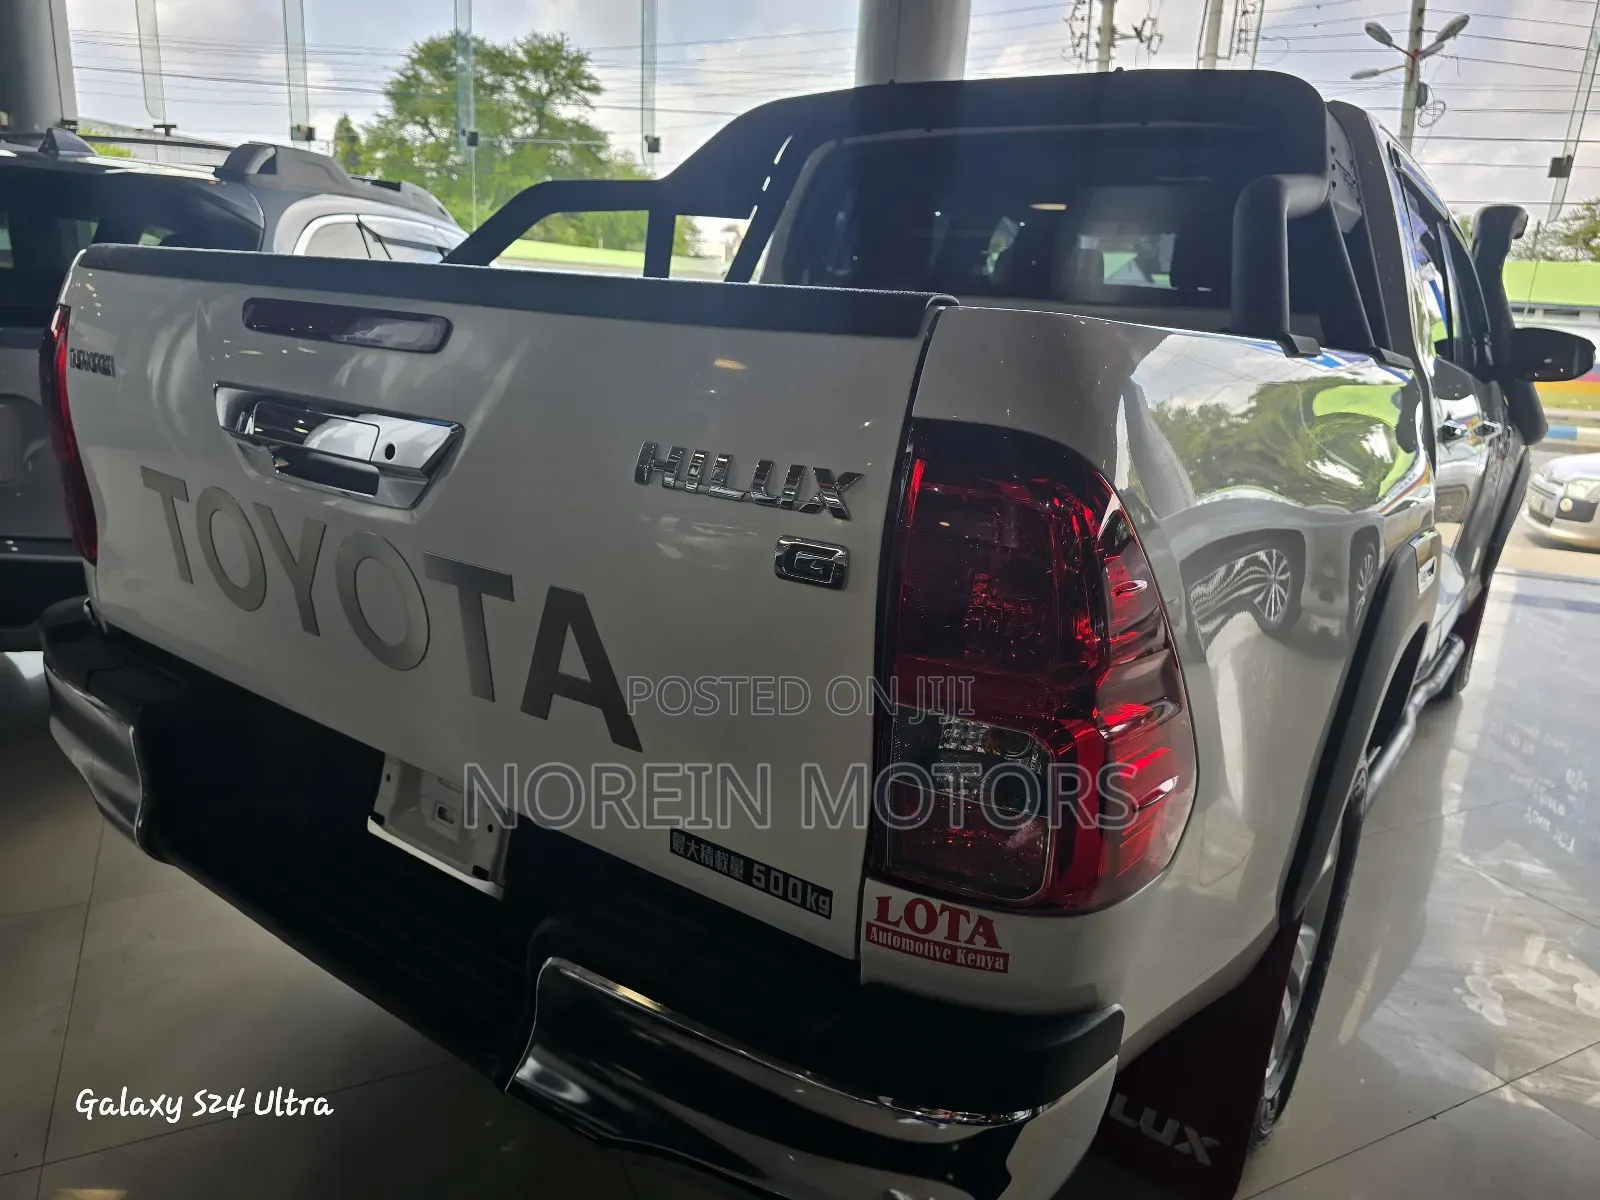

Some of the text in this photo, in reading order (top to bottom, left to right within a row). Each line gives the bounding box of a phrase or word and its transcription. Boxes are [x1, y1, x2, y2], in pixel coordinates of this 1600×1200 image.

[634, 440, 865, 521] HILUX
[140, 465, 643, 753] TOYOTA
[869, 926, 1004, 971] Automotive Kenya
[873, 895, 1003, 949] LOTA
